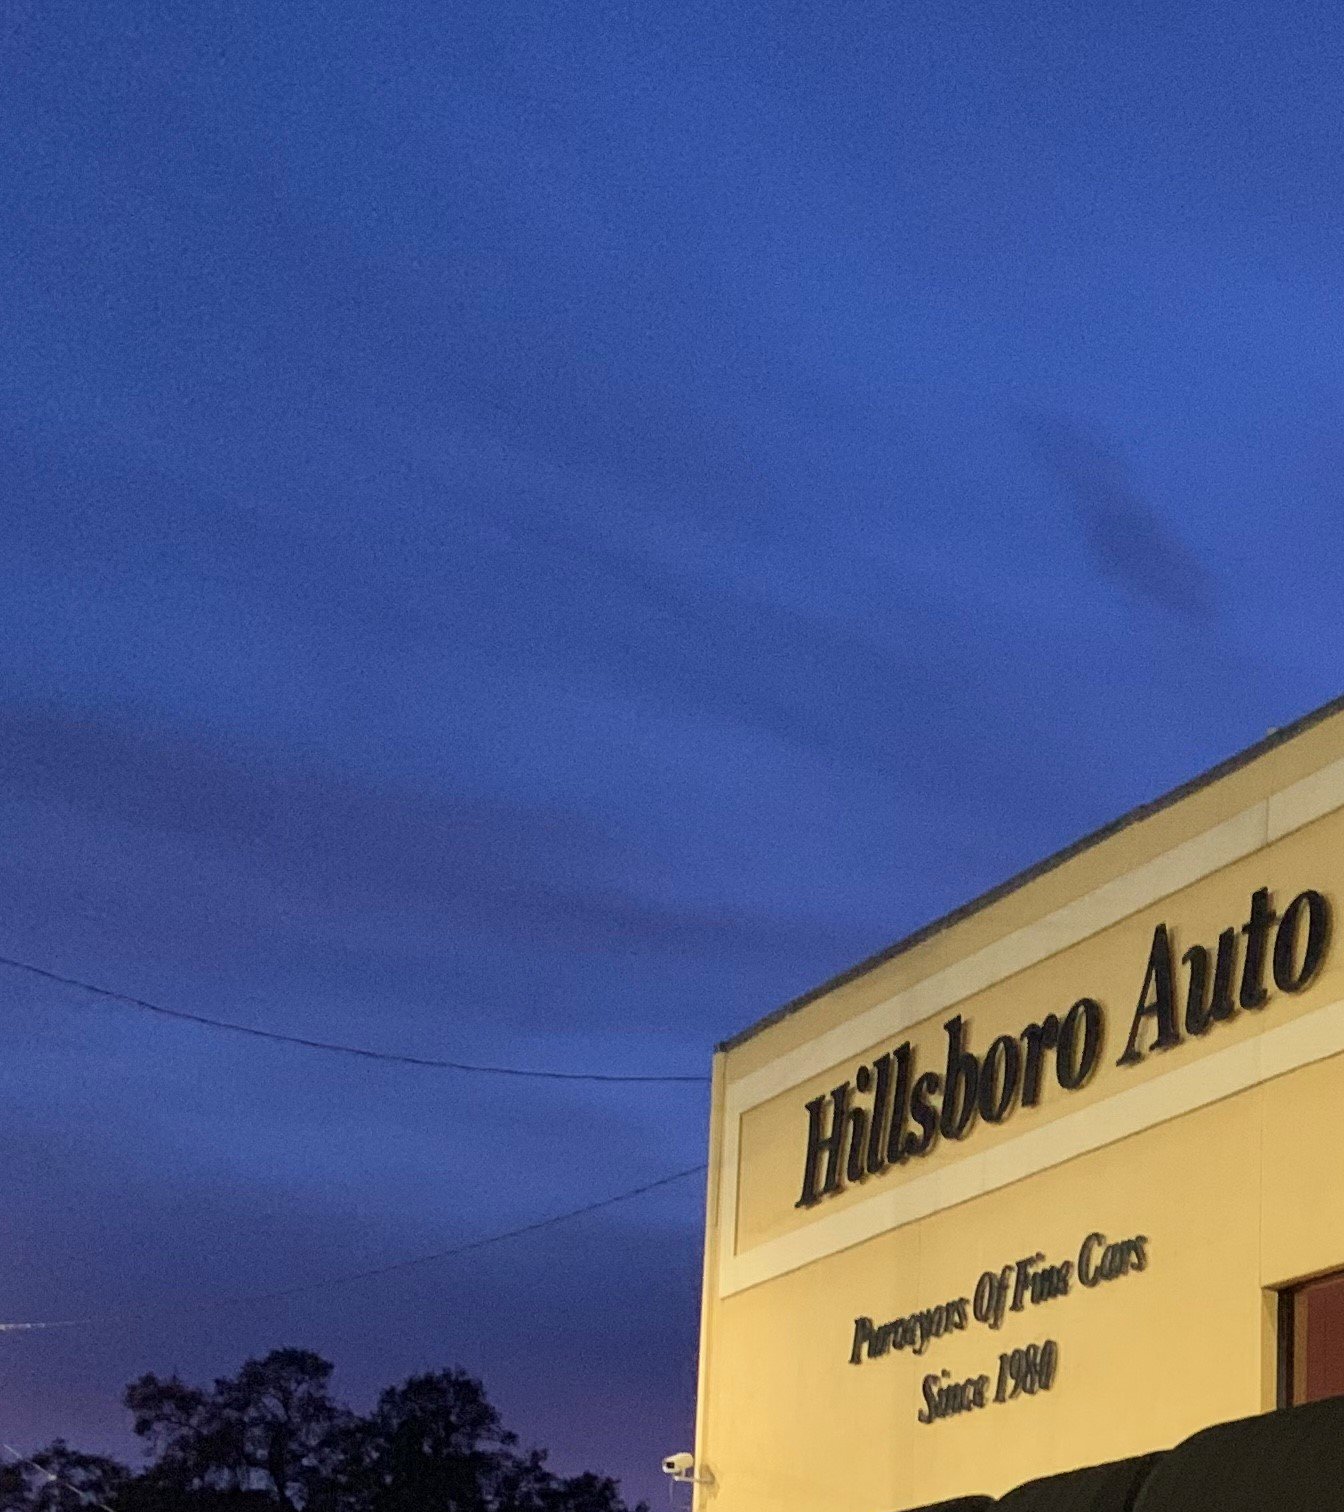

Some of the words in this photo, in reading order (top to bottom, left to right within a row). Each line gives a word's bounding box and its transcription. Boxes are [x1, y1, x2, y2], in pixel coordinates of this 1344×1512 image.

[795, 996, 1106, 1208] Hillsboro
[1117, 885, 1335, 1066] Auto
[849, 1297, 970, 1365] Purveyors
[973, 1265, 1014, 1330] Of
[1009, 1252, 1074, 1312] Fine
[1077, 1232, 1149, 1288] Cars
[917, 1368, 991, 1424] Since
[993, 1339, 1058, 1403] 1980
